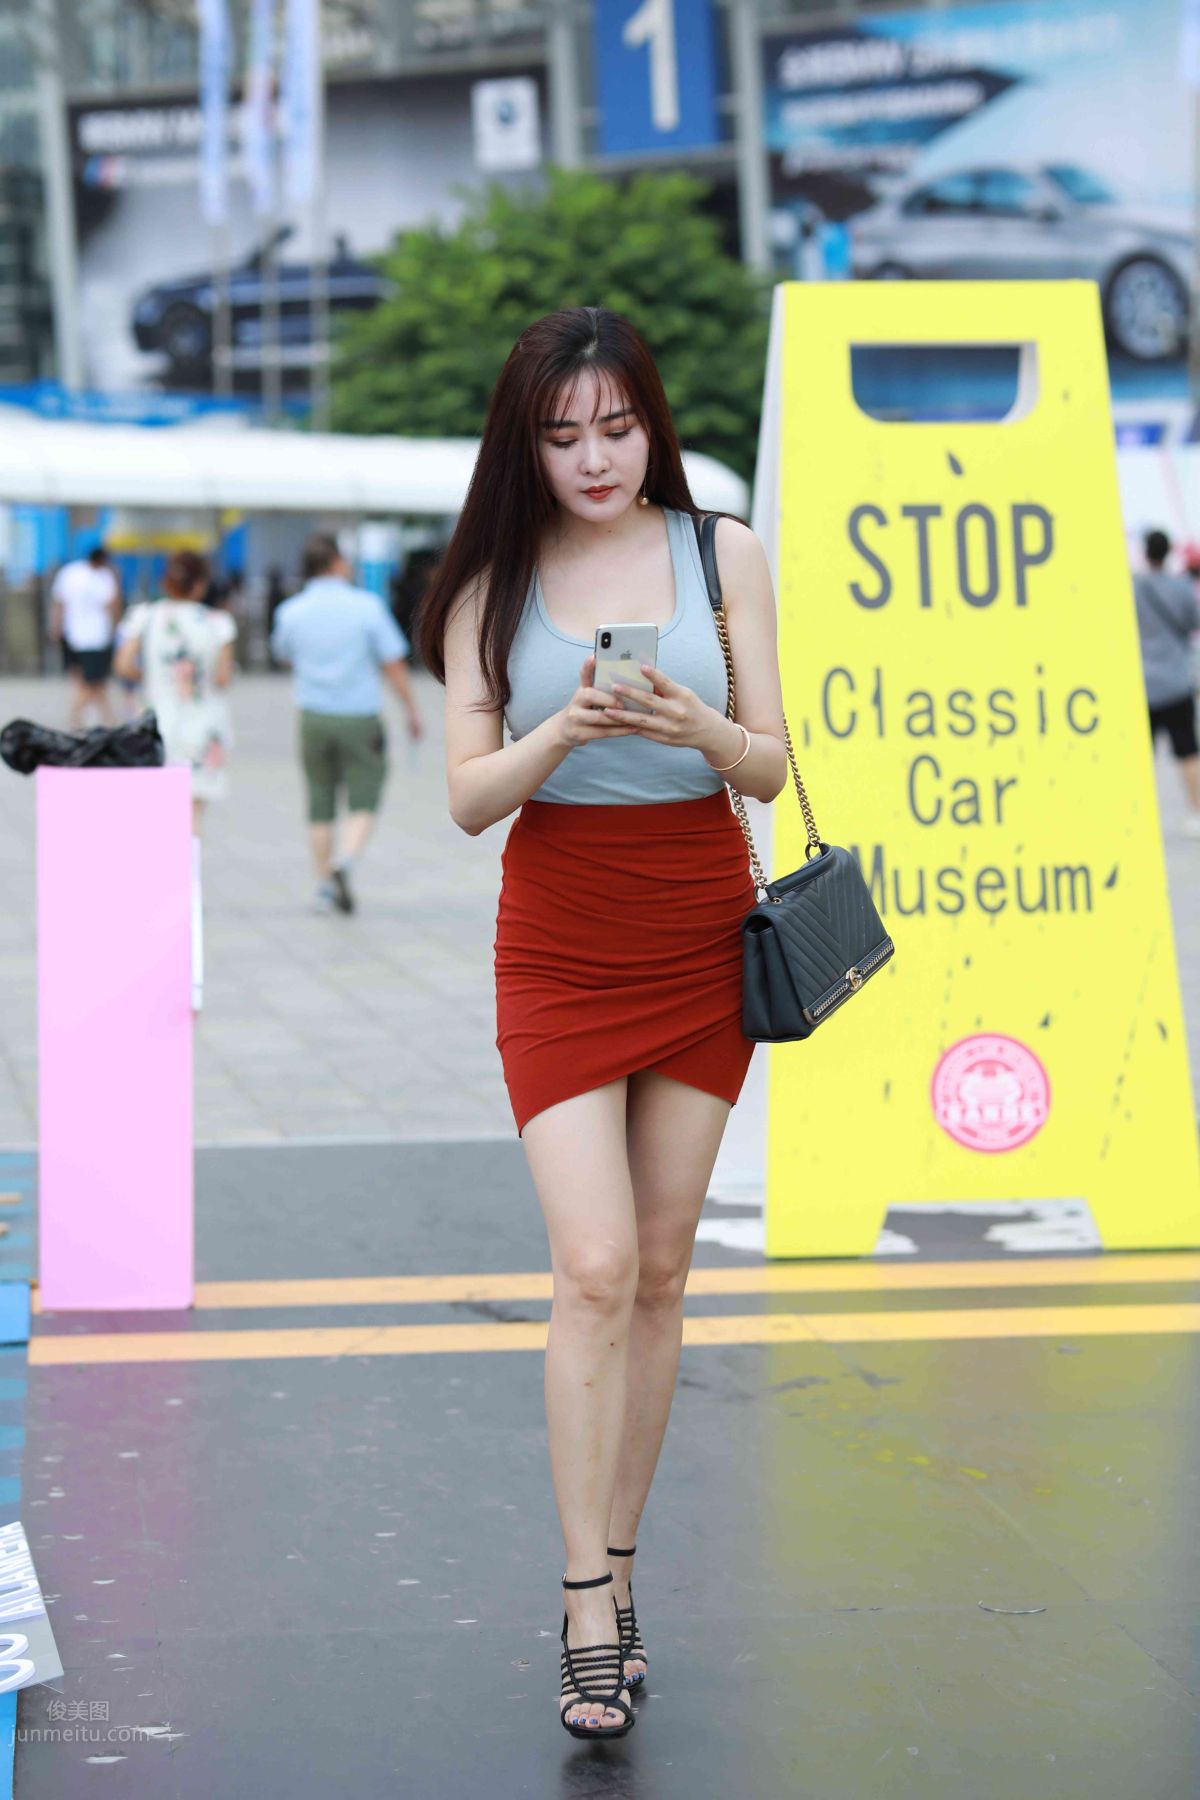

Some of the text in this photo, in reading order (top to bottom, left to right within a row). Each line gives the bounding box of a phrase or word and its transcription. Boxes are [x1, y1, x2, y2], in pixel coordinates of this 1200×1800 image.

[622, 0, 679, 133] 1
[848, 501, 1053, 609] STOP
[822, 664, 1098, 739] Classic
[907, 753, 1018, 825] Car
[850, 843, 1093, 916] Museum
